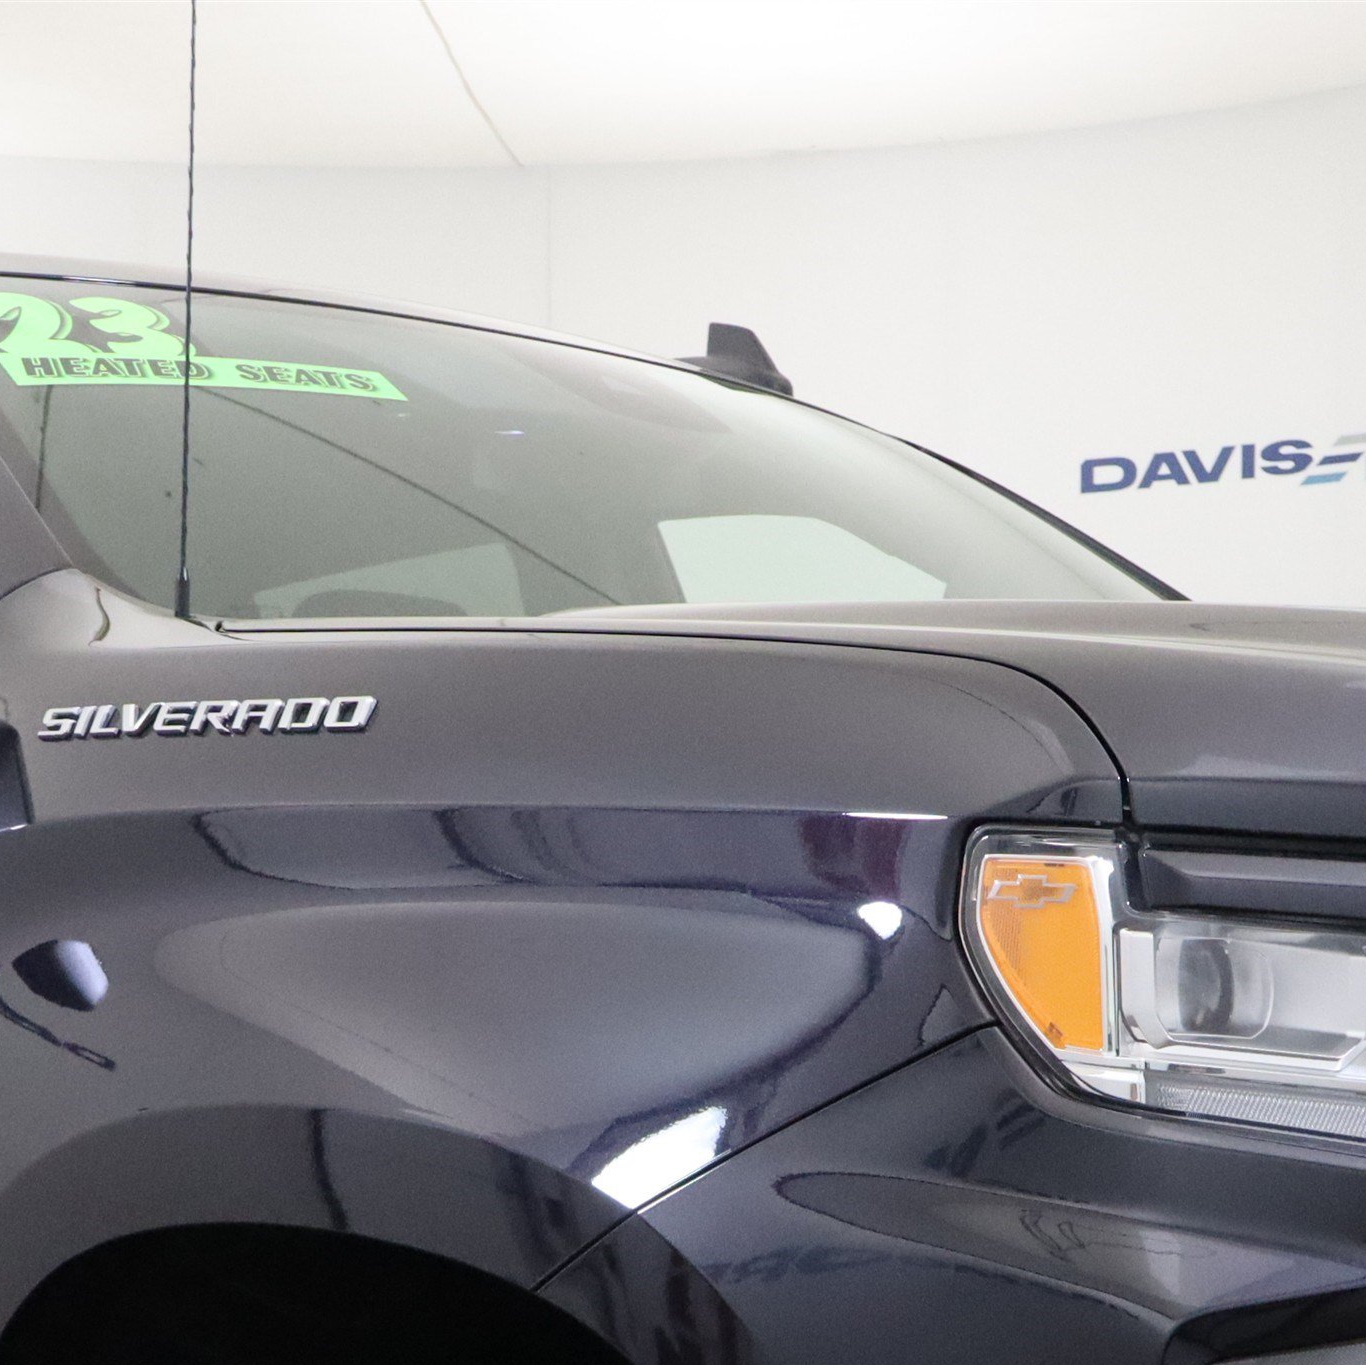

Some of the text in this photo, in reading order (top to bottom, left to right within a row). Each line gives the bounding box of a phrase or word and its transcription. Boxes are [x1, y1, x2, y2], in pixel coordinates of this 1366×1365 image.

[22, 356, 377, 391] HEATED SEATS
[1080, 440, 1314, 493] DAVIS
[37, 695, 378, 741] SILVERADO
